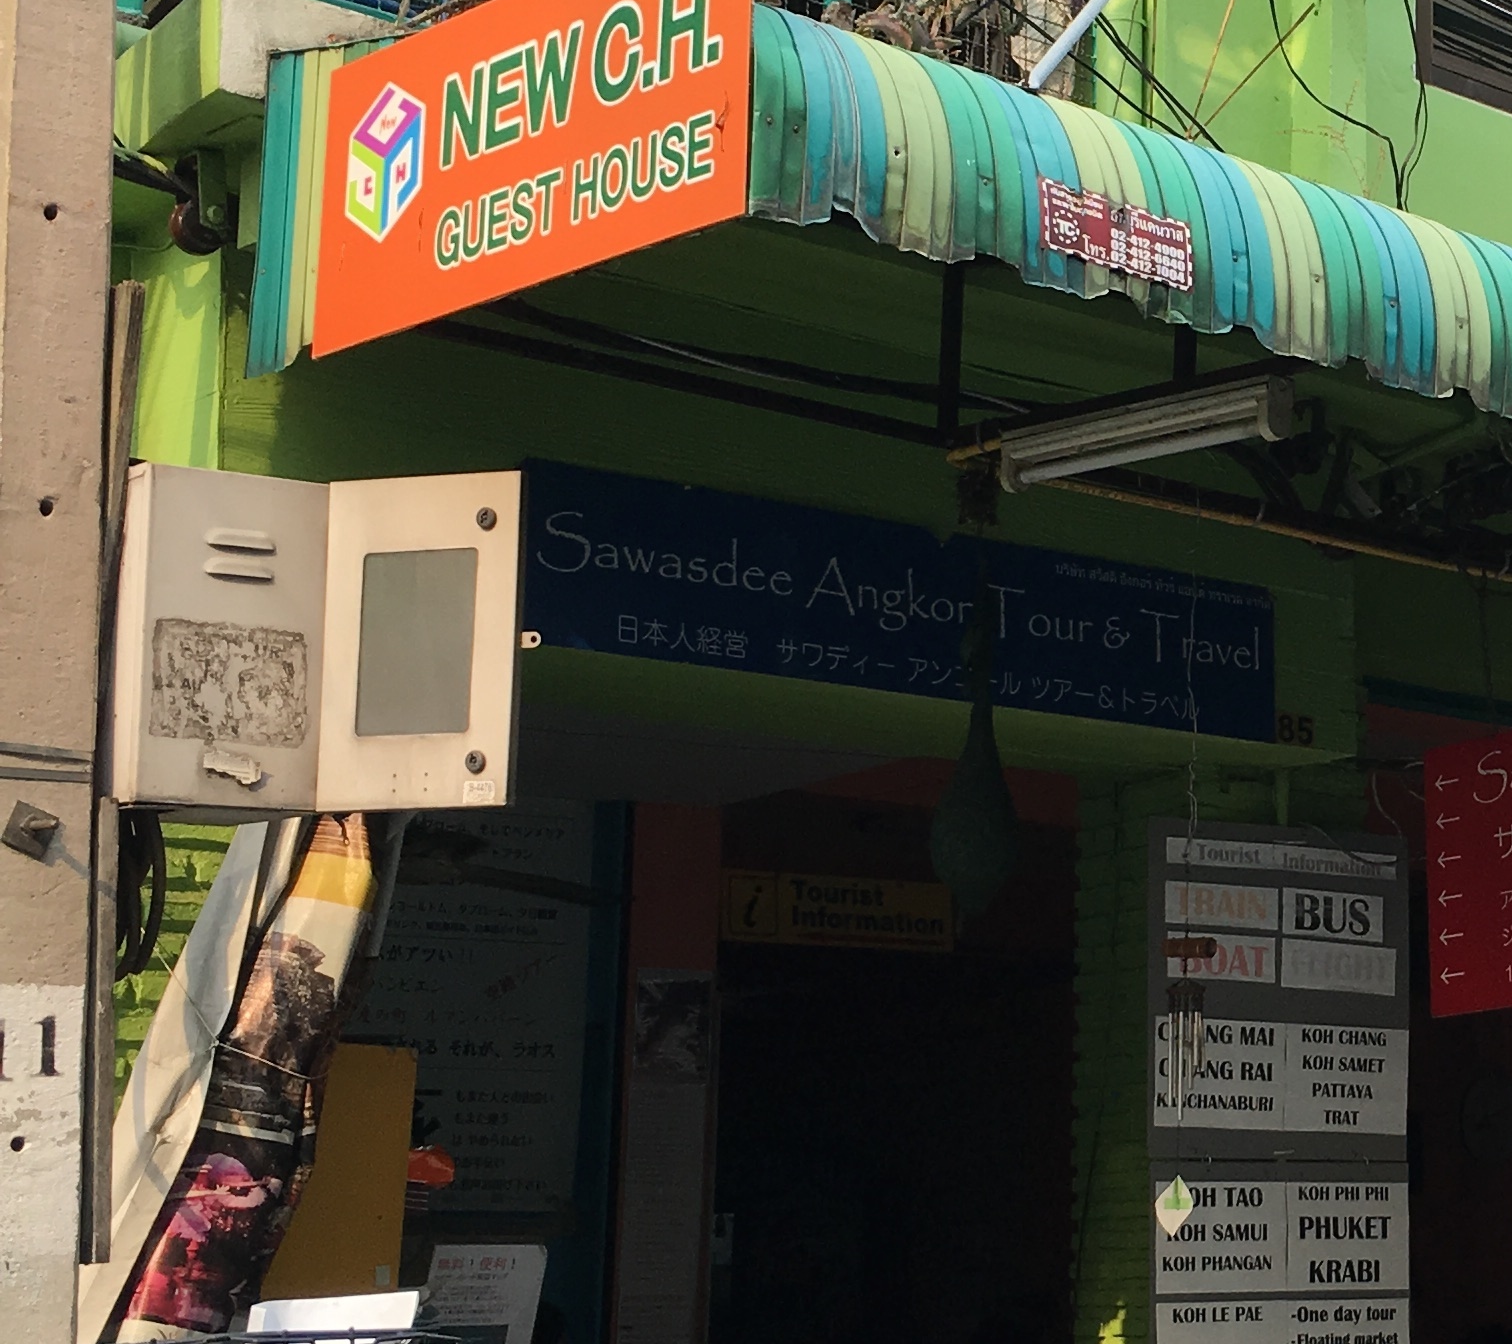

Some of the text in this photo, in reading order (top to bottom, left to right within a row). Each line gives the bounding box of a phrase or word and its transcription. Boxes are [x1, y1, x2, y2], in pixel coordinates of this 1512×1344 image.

[439, 20, 584, 172] NEW
[435, 110, 716, 271] GUEST HOUSE
[1057, 218, 1077, 236] TC
[536, 510, 1260, 671] Sawasdee Angkor Tour & Travel
[617, 613, 748, 659] 日本人経営
[776, 636, 895, 672] サワディー
[1277, 714, 1314, 745] 85
[791, 879, 884, 908] Tourist
[791, 904, 946, 937] Information
[1174, 885, 1371, 937] TRAIN BUS
[1240, 1025, 1275, 1047] MAI
[1302, 1028, 1387, 1047] KOH CHANG
[1240, 1060, 1274, 1082] RAI
[1302, 1055, 1386, 1074] KOH SAMET
[1312, 1081, 1374, 1100] PATTAYA
[1323, 1109, 1360, 1126] TRAT
[1223, 1187, 1264, 1208] TAO
[1298, 1185, 1390, 1202] KOH PHI PHI
[1213, 1223, 1268, 1242] SAMUI
[1299, 1215, 1392, 1240] PHUKET
[1162, 1255, 1273, 1272] KOH PHANGAN
[1308, 1259, 1381, 1284] KRABI
[1172, 1306, 1264, 1323] KOH LE PAE
[1333, 1306, 1362, 1326] day
[1366, 1305, 1397, 1322] tour
